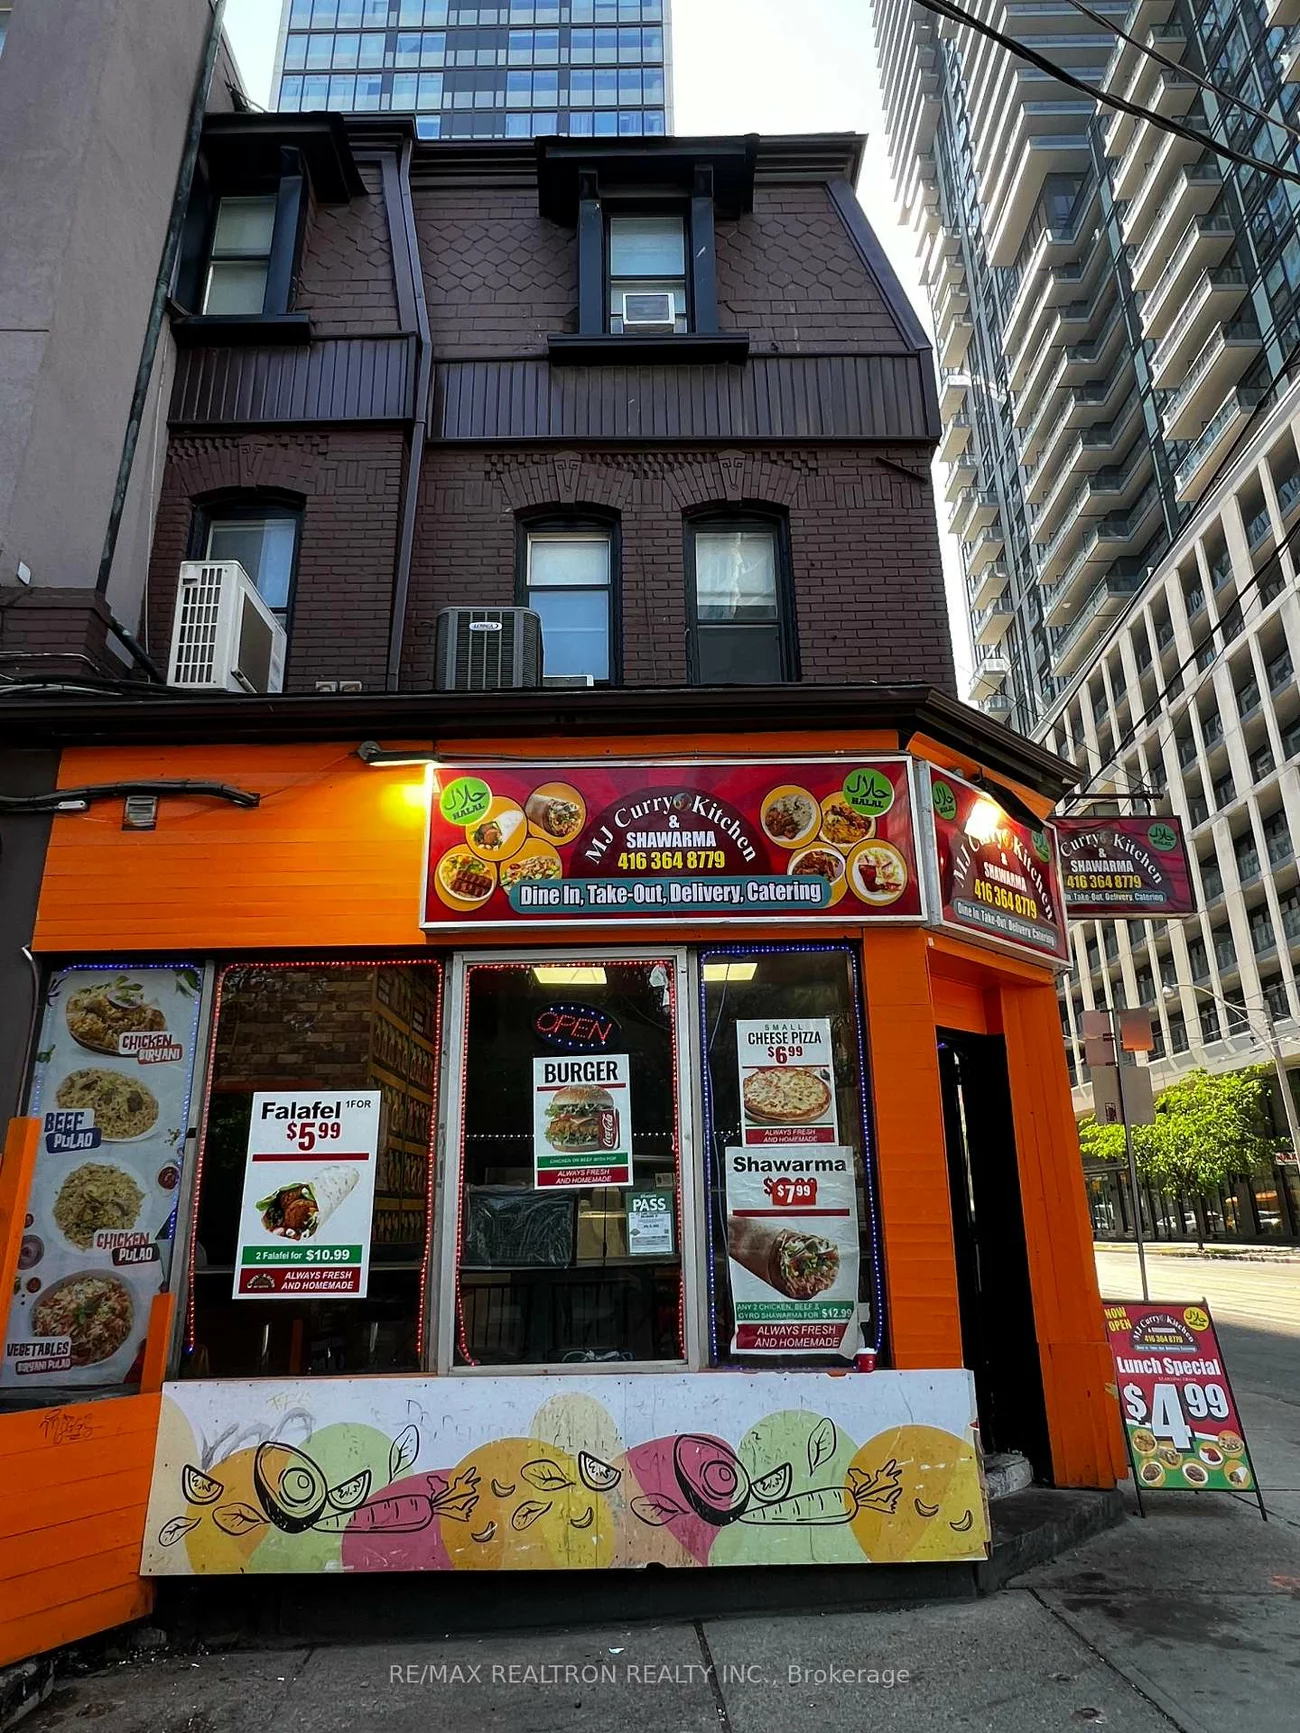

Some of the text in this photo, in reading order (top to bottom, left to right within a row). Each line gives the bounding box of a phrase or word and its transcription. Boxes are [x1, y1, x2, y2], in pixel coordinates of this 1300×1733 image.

[846, 774, 890, 799] حلال
[444, 784, 487, 811] حلال
[851, 797, 884, 808] HALAL
[452, 803, 485, 820] HALAL
[668, 814, 680, 829] &
[585, 794, 757, 865] MJ Curry Kitchen
[626, 831, 717, 848] SHAWARMA
[618, 850, 725, 870] 416 364 8779
[1060, 833, 1100, 858] Curry
[1113, 833, 1163, 884] Kitchen
[1098, 848, 1107, 858] &
[1070, 860, 1134, 873] SHAWARMA
[983, 861, 1027, 893] SHAWARMA
[1013, 834, 1053, 920] Kitchen
[1067, 875, 1142, 889] 416 364 8779
[520, 881, 821, 907] Dine In, Take-Out, Delivery, Catering
[974, 878, 1037, 919] 416 364 8779
[1134, 892, 1164, 902] Catering
[537, 1011, 612, 1041] OPEN
[765, 1023, 803, 1031] SMALL
[122, 1034, 173, 1050] CHICKEN
[748, 1031, 822, 1045] CHEESE PIZZA
[139, 1048, 180, 1062] BIRYANI
[544, 1060, 618, 1083] BURGER
[261, 1100, 371, 1120] Falafel 1FOR
[45, 1112, 85, 1133] BEEF
[53, 1132, 93, 1149] PULAO
[733, 1156, 847, 1173] Shawarma
[557, 1168, 610, 1177] ALWAYS FRESH
[571, 1175, 612, 1183] HOMEMADE
[632, 1198, 666, 1211] PASS
[96, 1232, 150, 1249] CHICKEN
[119, 1247, 153, 1261] PULAO
[263, 1251, 289, 1259] Falafel
[290, 1251, 302, 1259] for
[306, 1249, 350, 1261] $10.99
[284, 1271, 352, 1280] ALWAYS FRESH
[281, 1281, 354, 1290] AND HOMEMADE
[761, 1311, 802, 1319] SHAWARMA
[821, 1307, 852, 1318] $12.99
[1104, 1306, 1127, 1319] NOW
[757, 1325, 836, 1335] ALWAYS FRESH
[1108, 1318, 1132, 1332] OPEN
[1140, 1315, 1160, 1328] Curry
[1166, 1315, 1194, 1343] Kitchen
[7, 1341, 69, 1357] VEGETABLES
[754, 1337, 840, 1347] AND HOMEMADE
[48, 1359, 71, 1369] PULAO
[1116, 1356, 1221, 1376] Lunch Special
